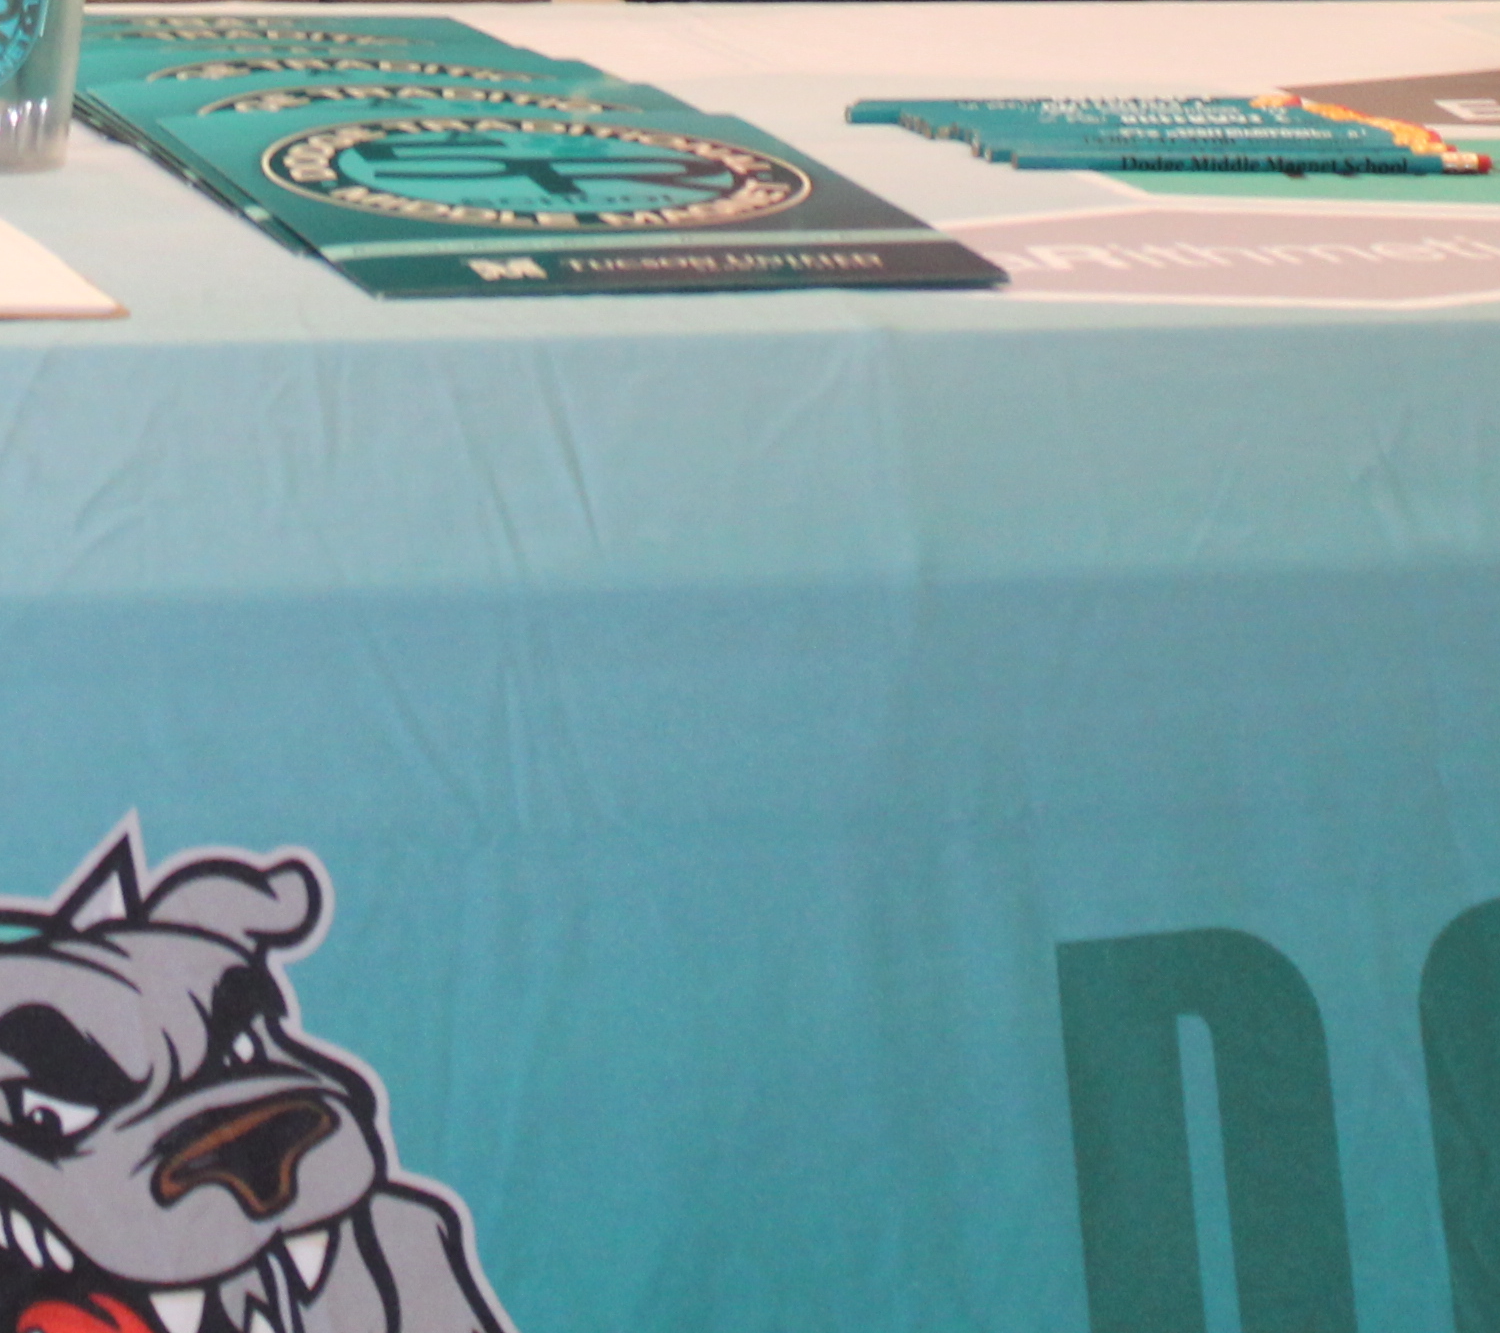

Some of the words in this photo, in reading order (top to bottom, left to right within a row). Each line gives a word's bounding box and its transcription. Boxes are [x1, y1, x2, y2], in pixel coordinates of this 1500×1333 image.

[1121, 155, 1184, 172] Dodge
[1191, 154, 1257, 171] Middle
[1265, 154, 1337, 173] Magnet
[1341, 155, 1409, 173] School
